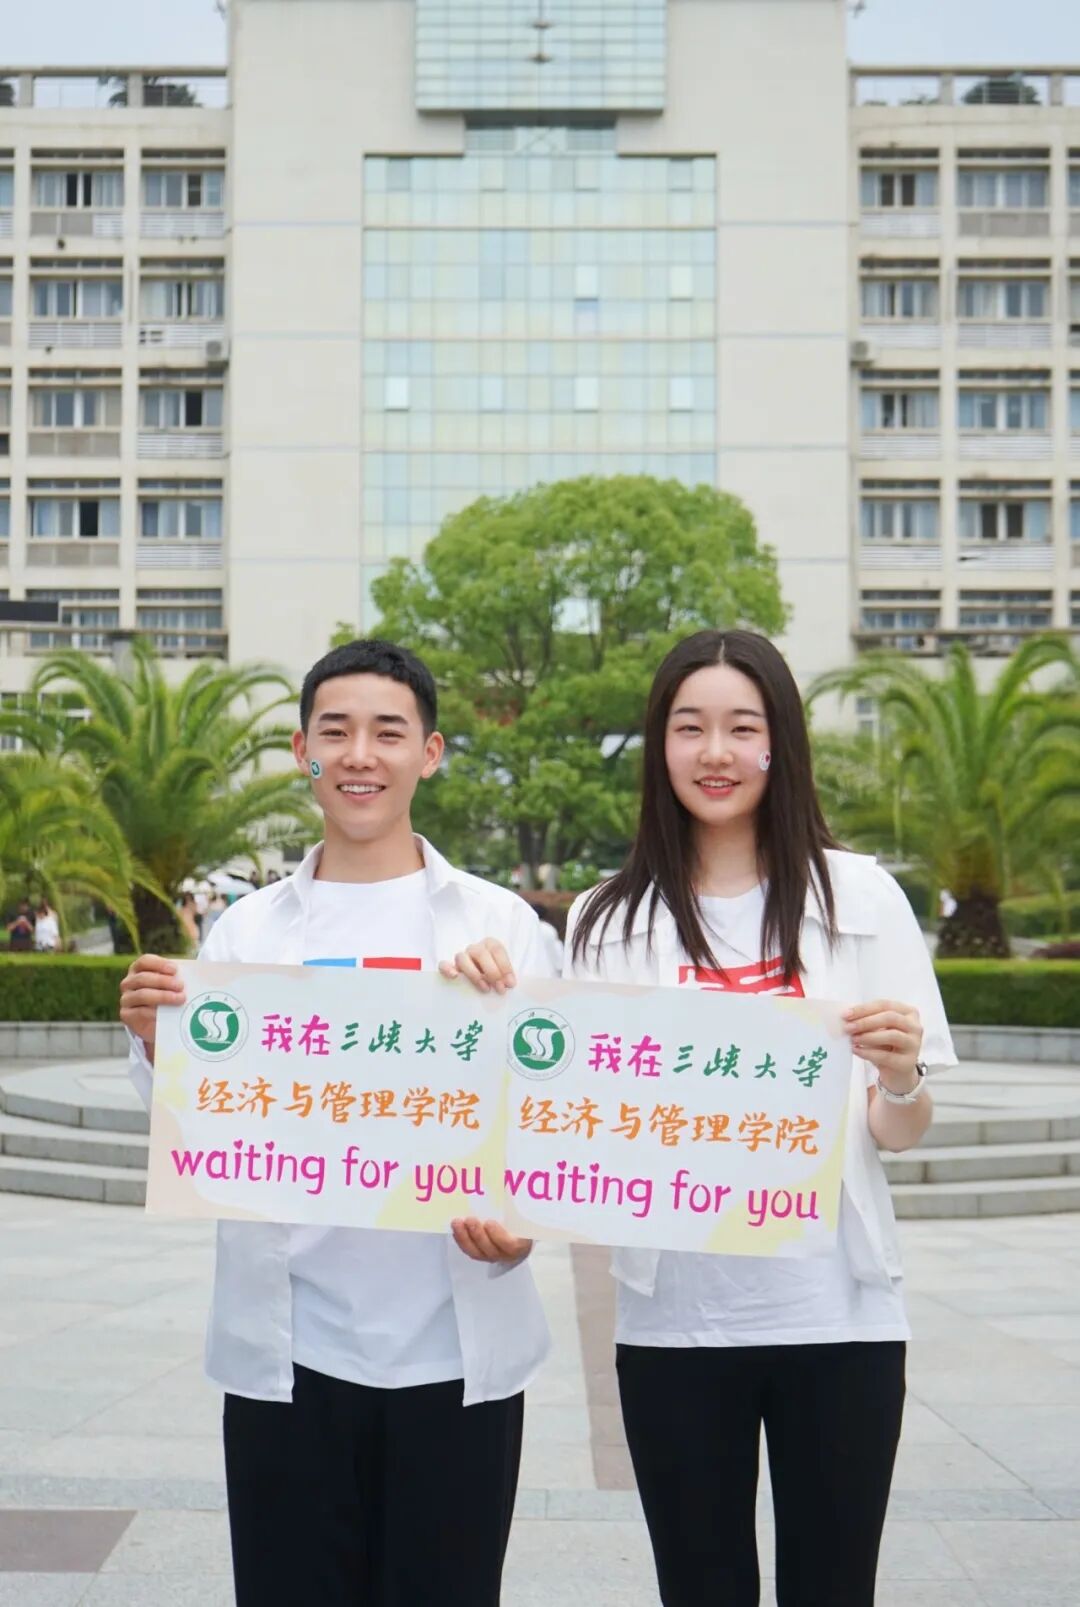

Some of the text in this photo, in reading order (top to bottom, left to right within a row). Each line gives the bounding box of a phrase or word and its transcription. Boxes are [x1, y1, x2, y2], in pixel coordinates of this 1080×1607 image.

[262, 1014, 484, 1061] 我在三峡大学
[588, 1034, 828, 1087] 我在三峡大学
[198, 1077, 480, 1130] 经济与管理学院
[518, 1095, 820, 1155] 经济与管理学院
[171, 1139, 485, 1202] waiting for you
[671, 1169, 732, 1214] for
[748, 1188, 819, 1227] you
